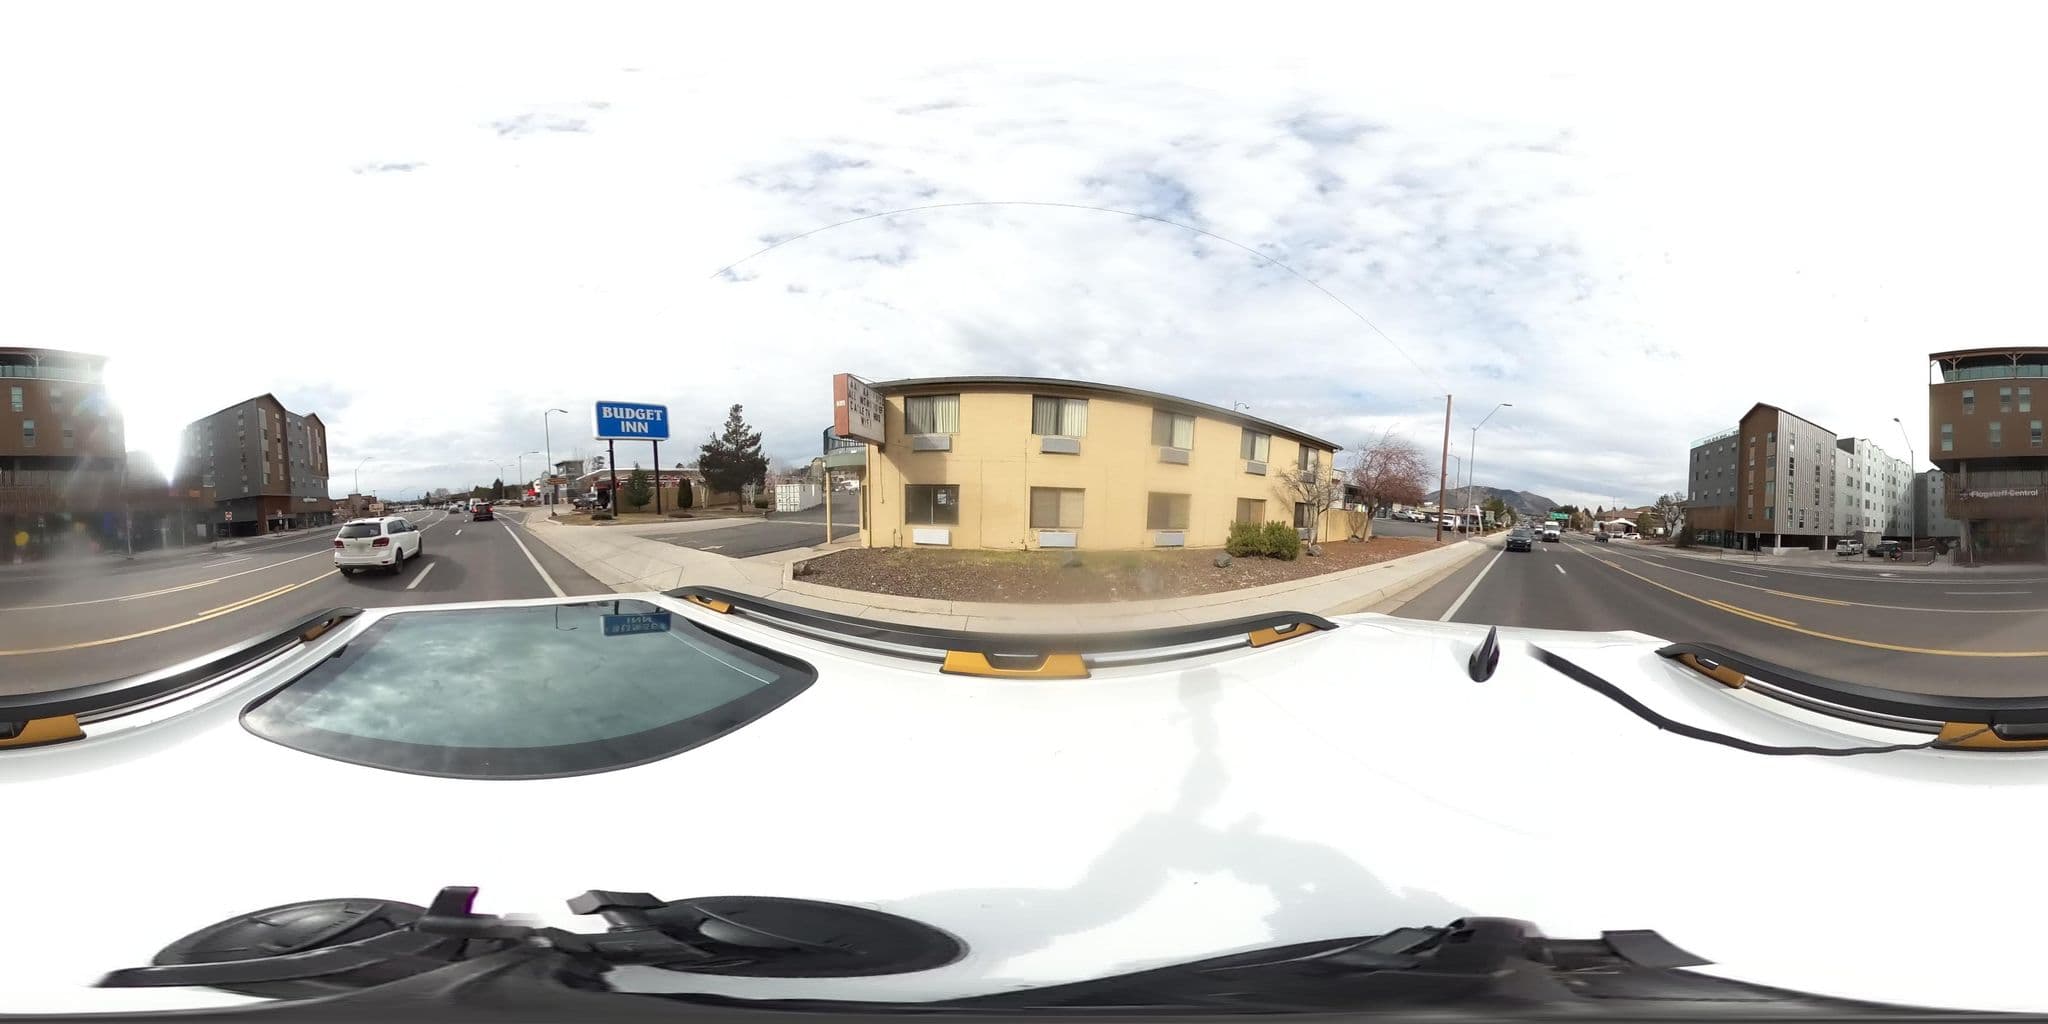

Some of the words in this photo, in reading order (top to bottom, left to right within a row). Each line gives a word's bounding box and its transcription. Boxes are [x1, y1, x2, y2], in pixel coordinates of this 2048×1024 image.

[602, 406, 663, 421] BUDGET
[620, 421, 649, 433] INN
[2009, 488, 2038, 497] Central
